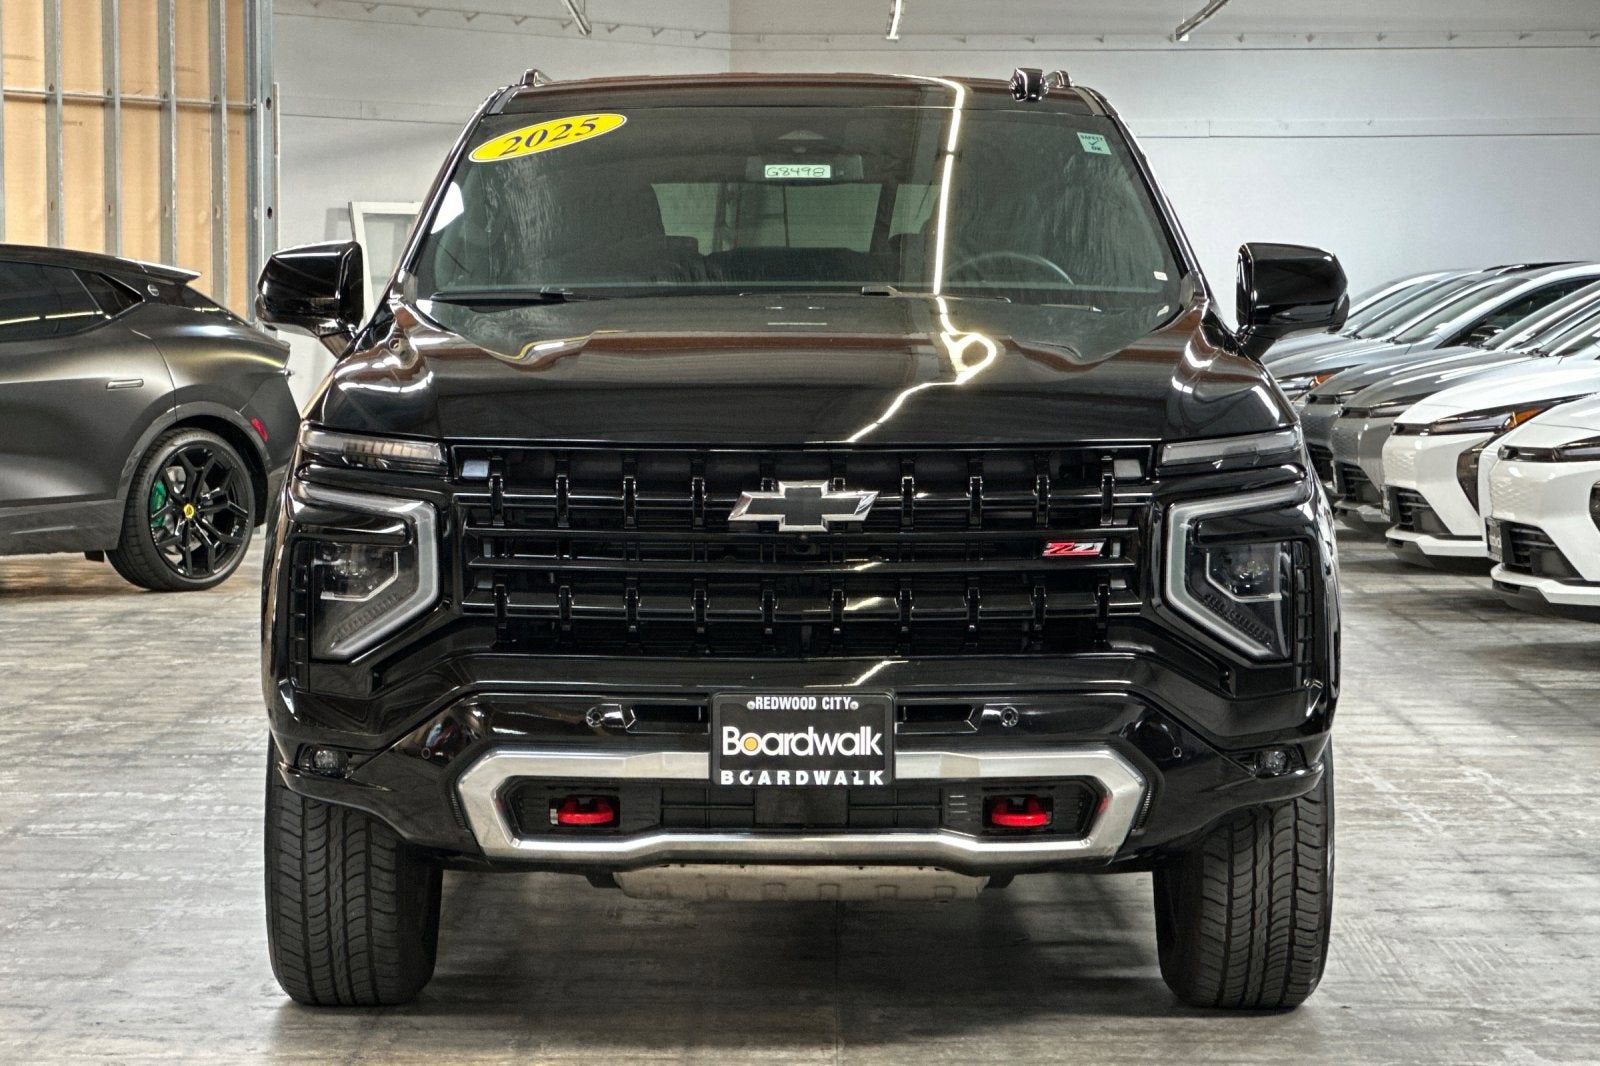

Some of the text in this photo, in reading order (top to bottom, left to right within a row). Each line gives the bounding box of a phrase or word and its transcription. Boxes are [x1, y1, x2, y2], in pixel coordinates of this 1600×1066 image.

[499, 117, 600, 157] 2025
[767, 167, 825, 176] G8498
[755, 696, 851, 710] REDWOOD CITY
[722, 725, 883, 756] Boardwalk
[721, 770, 884, 785] BOARDWALK
